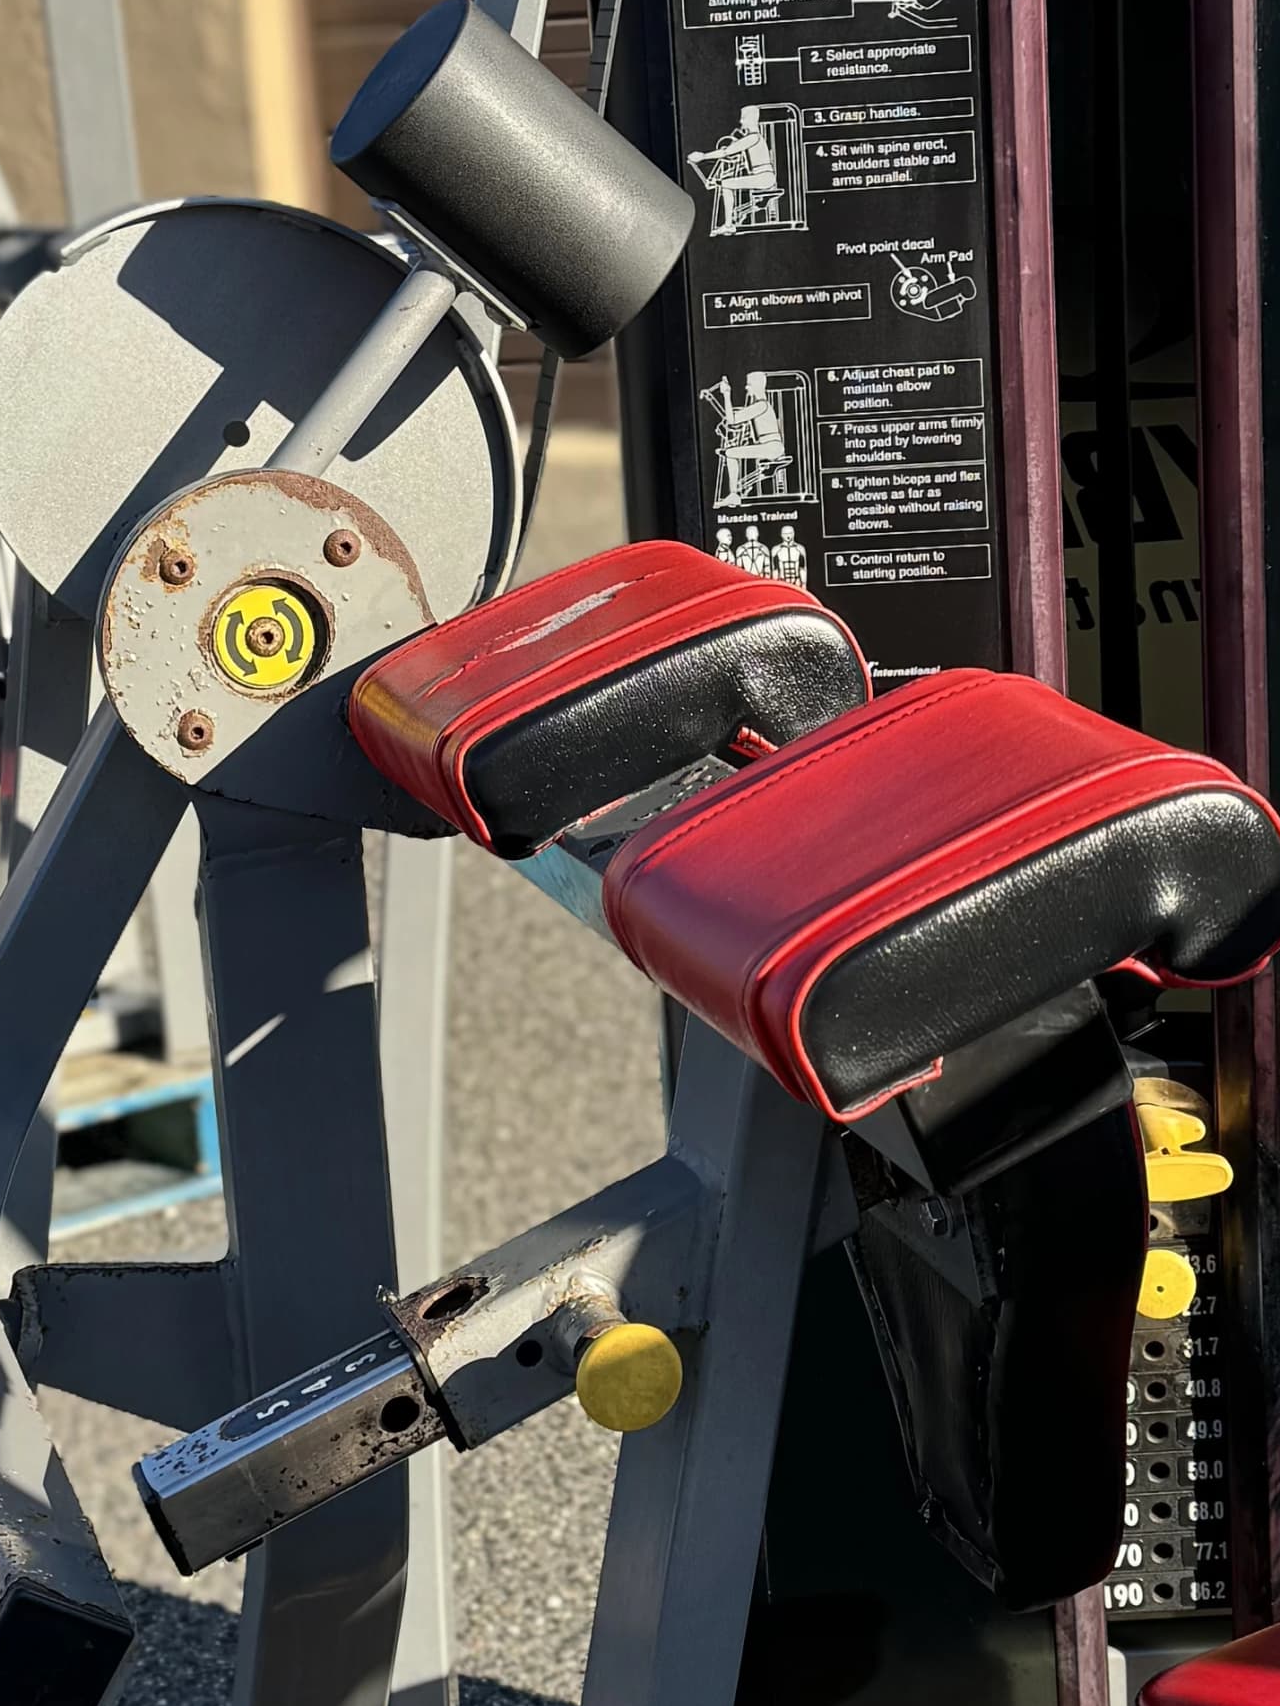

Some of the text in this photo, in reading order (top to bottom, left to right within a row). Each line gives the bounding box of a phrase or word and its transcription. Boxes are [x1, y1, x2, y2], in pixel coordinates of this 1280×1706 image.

[709, 7, 780, 22] rest on pad.
[810, 44, 936, 63] 2. Select appropriate
[827, 63, 892, 77] resistance.
[814, 106, 920, 123] 3. Grasp handles.
[815, 138, 947, 157] 4. Sit with spine erect,
[831, 152, 955, 172] shoulders stable and
[832, 171, 912, 187] arms parallel.
[837, 238, 935, 255] Pivot point decal
[921, 250, 973, 264] Arm Pad
[714, 290, 862, 309] 5. Align elbows with pivot
[730, 310, 762, 324] point.
[827, 365, 955, 382] 6. Adjust chest pad to
[843, 381, 931, 395] maintain elbow
[844, 397, 893, 412] position.
[829, 417, 983, 435] 7. Press upper arms firmly
[845, 433, 961, 449] into pad by lowering
[846, 450, 906, 463] shoulders.
[831, 471, 981, 490] 8. Tighten biceps and flex
[847, 487, 941, 502] elbows as far as
[718, 510, 798, 524] Muscles Trained
[848, 499, 983, 518] possible without raising
[848, 517, 893, 530] elbows.
[836, 550, 945, 566] 9. Control return to
[853, 565, 947, 581] starting position.
[1182, 1297, 1216, 1316] 2.7
[345, 1353, 376, 1372] 3
[301, 1375, 332, 1394] 4
[1186, 1378, 1221, 1398] 40.8
[257, 1399, 290, 1420] 5
[1187, 1420, 1222, 1440] 49.9
[1188, 1461, 1223, 1481] 59.0
[1189, 1501, 1224, 1521] 68.0
[1114, 1543, 1142, 1568] 70
[1193, 1541, 1227, 1560] 77.1
[1104, 1582, 1143, 1609] 190
[1190, 1581, 1226, 1601] 86.2
